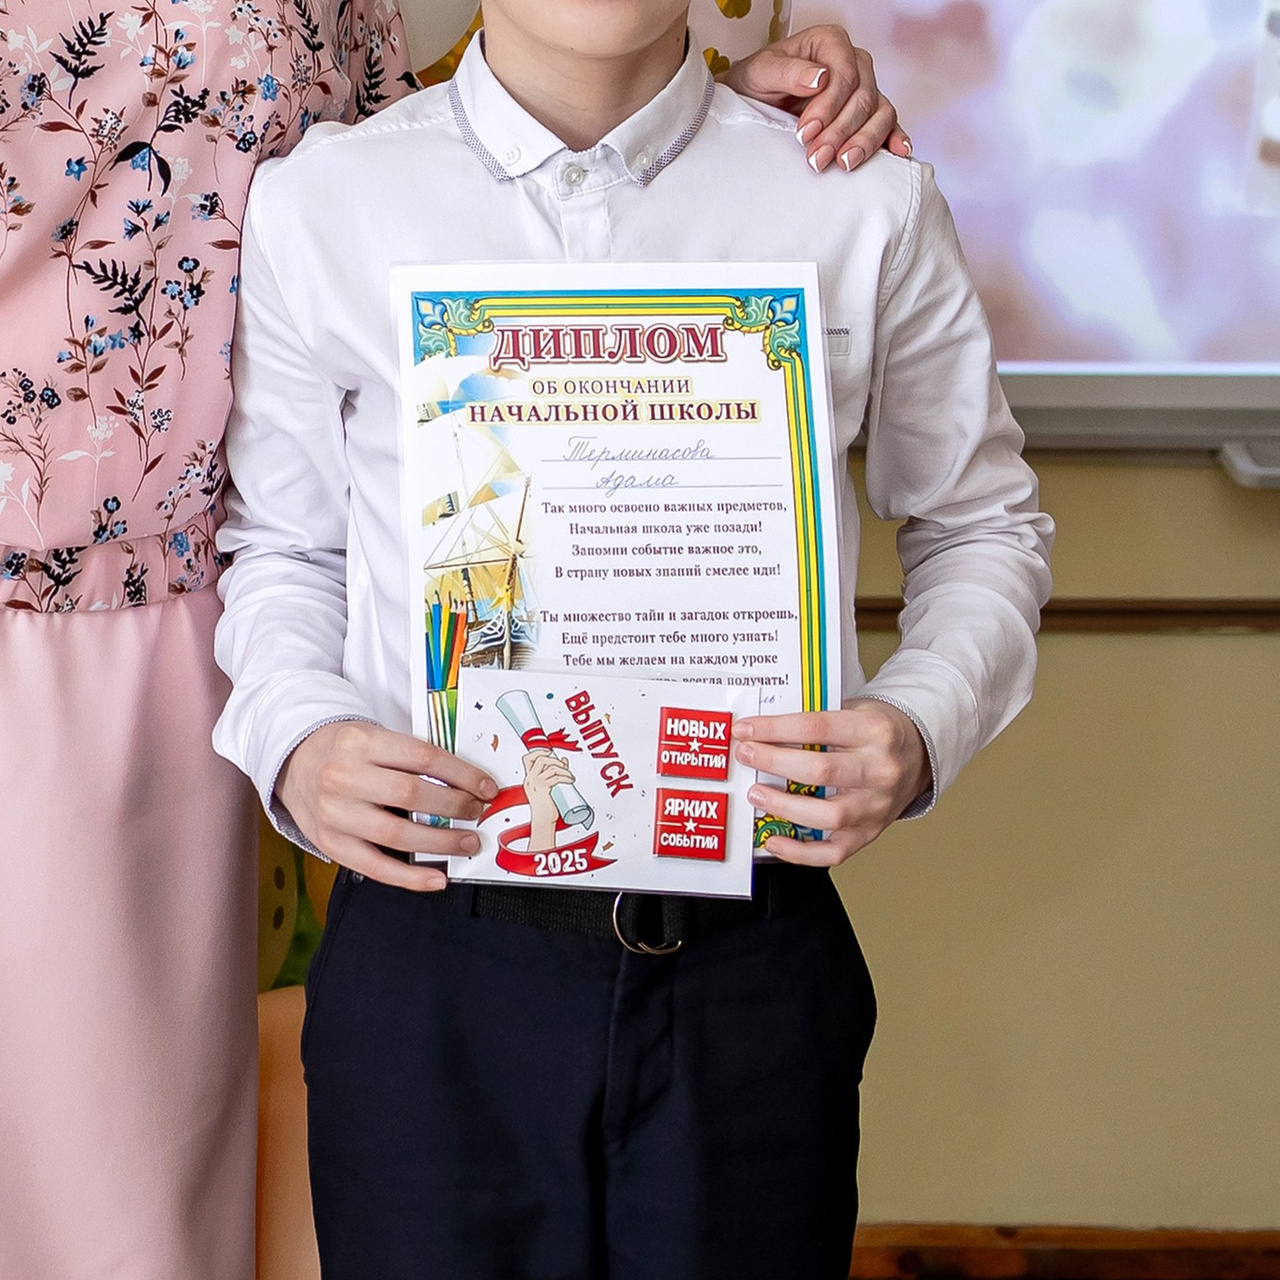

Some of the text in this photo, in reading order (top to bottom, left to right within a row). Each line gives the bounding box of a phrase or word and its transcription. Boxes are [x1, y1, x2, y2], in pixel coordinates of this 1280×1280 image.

[491, 324, 726, 370] ДИПЛОМ
[532, 379, 690, 395] ОБ ОКОНЧАНИИ
[469, 400, 758, 422] НАЧАЛЬНОЙ ШКОЛЫ
[541, 502, 787, 515] Так много освоено важных предметов,
[569, 522, 763, 536] Начальная школа уже позади!
[571, 543, 762, 556] Запомни событие важное это,
[555, 564, 781, 581] В страну новых знаний смелее иди!
[540, 609, 798, 623] Ты множество тайн и загадок откроешь,
[562, 630, 779, 647] Ещё предстоит тебе много узнать!
[563, 653, 778, 667] Тебе мы желаем на каждом уроке
[666, 717, 726, 740] НОВЫХ
[565, 690, 635, 799] ВЫПУСК
[661, 752, 726, 770] ОТКРЫТИЙ
[663, 797, 719, 820] ЯРКИХ
[660, 832, 719, 851] СОБЫТИЙ
[533, 848, 588, 876] 2025
